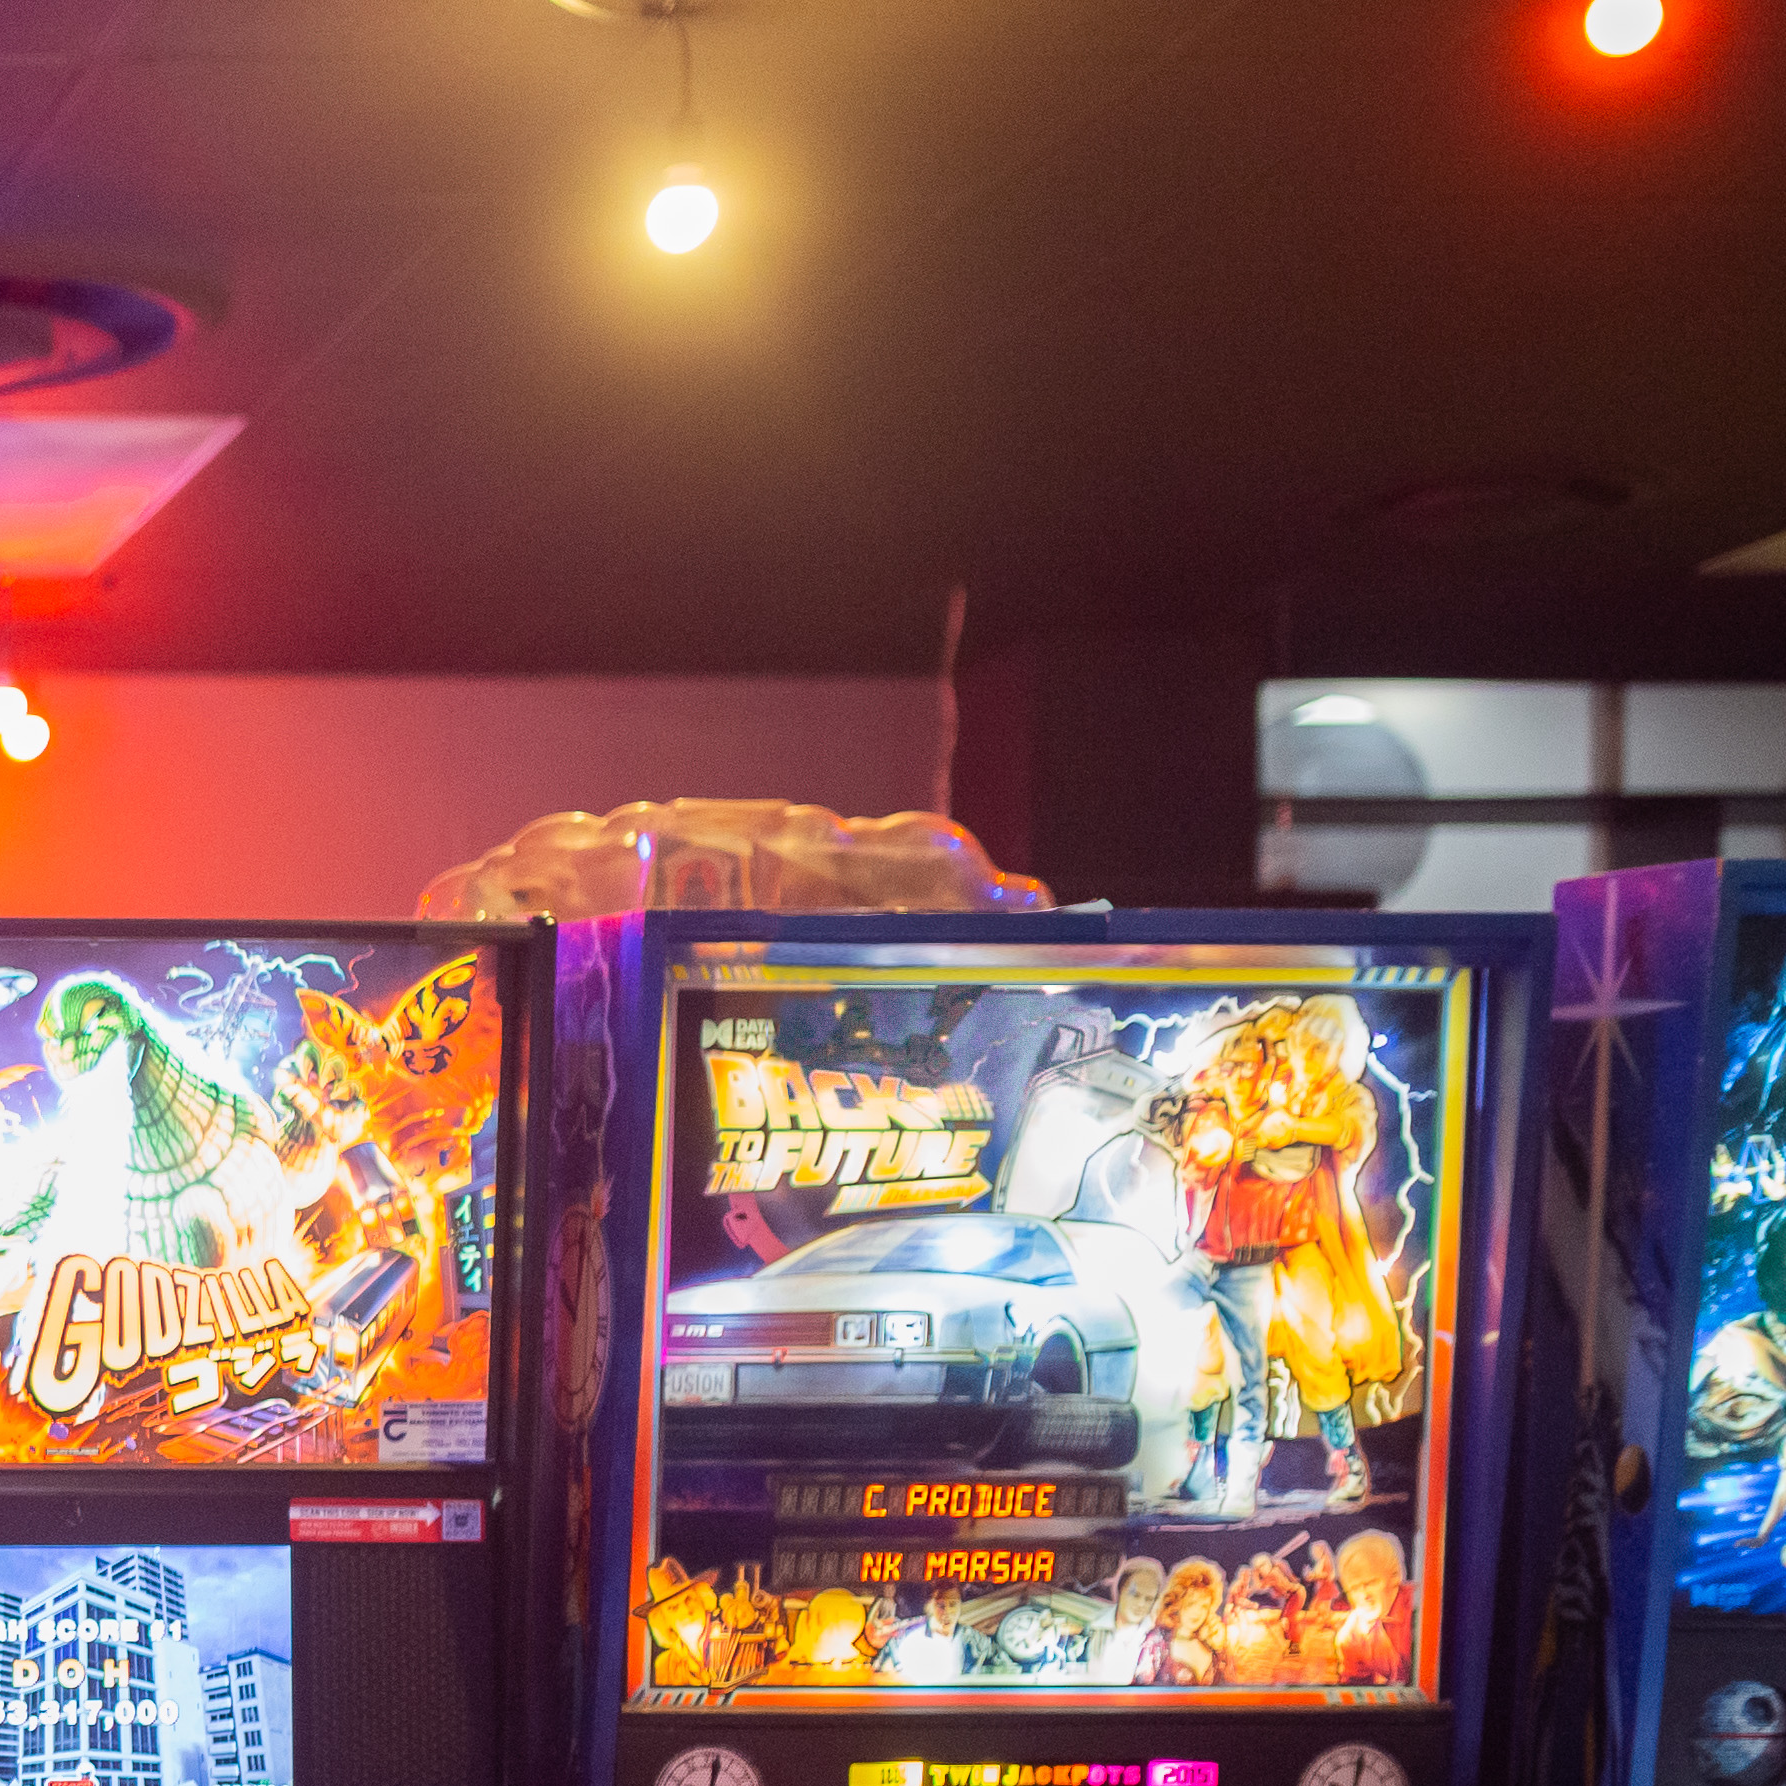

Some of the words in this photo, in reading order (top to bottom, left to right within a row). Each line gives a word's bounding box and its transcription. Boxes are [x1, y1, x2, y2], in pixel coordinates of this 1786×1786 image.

[735, 1018, 776, 1033] DATA
[708, 1050, 945, 1130] BACK
[718, 1130, 765, 1162] TO
[757, 1130, 992, 1193] FUTURE
[28, 1252, 312, 1416] GODZILLA
[167, 1326, 320, 1418] ゴジラ
[905, 1483, 1057, 1518] PRODUCE
[859, 1551, 904, 1583] NK
[925, 1550, 1057, 1584] MARSHA
[36, 1618, 141, 1643] SCORE
